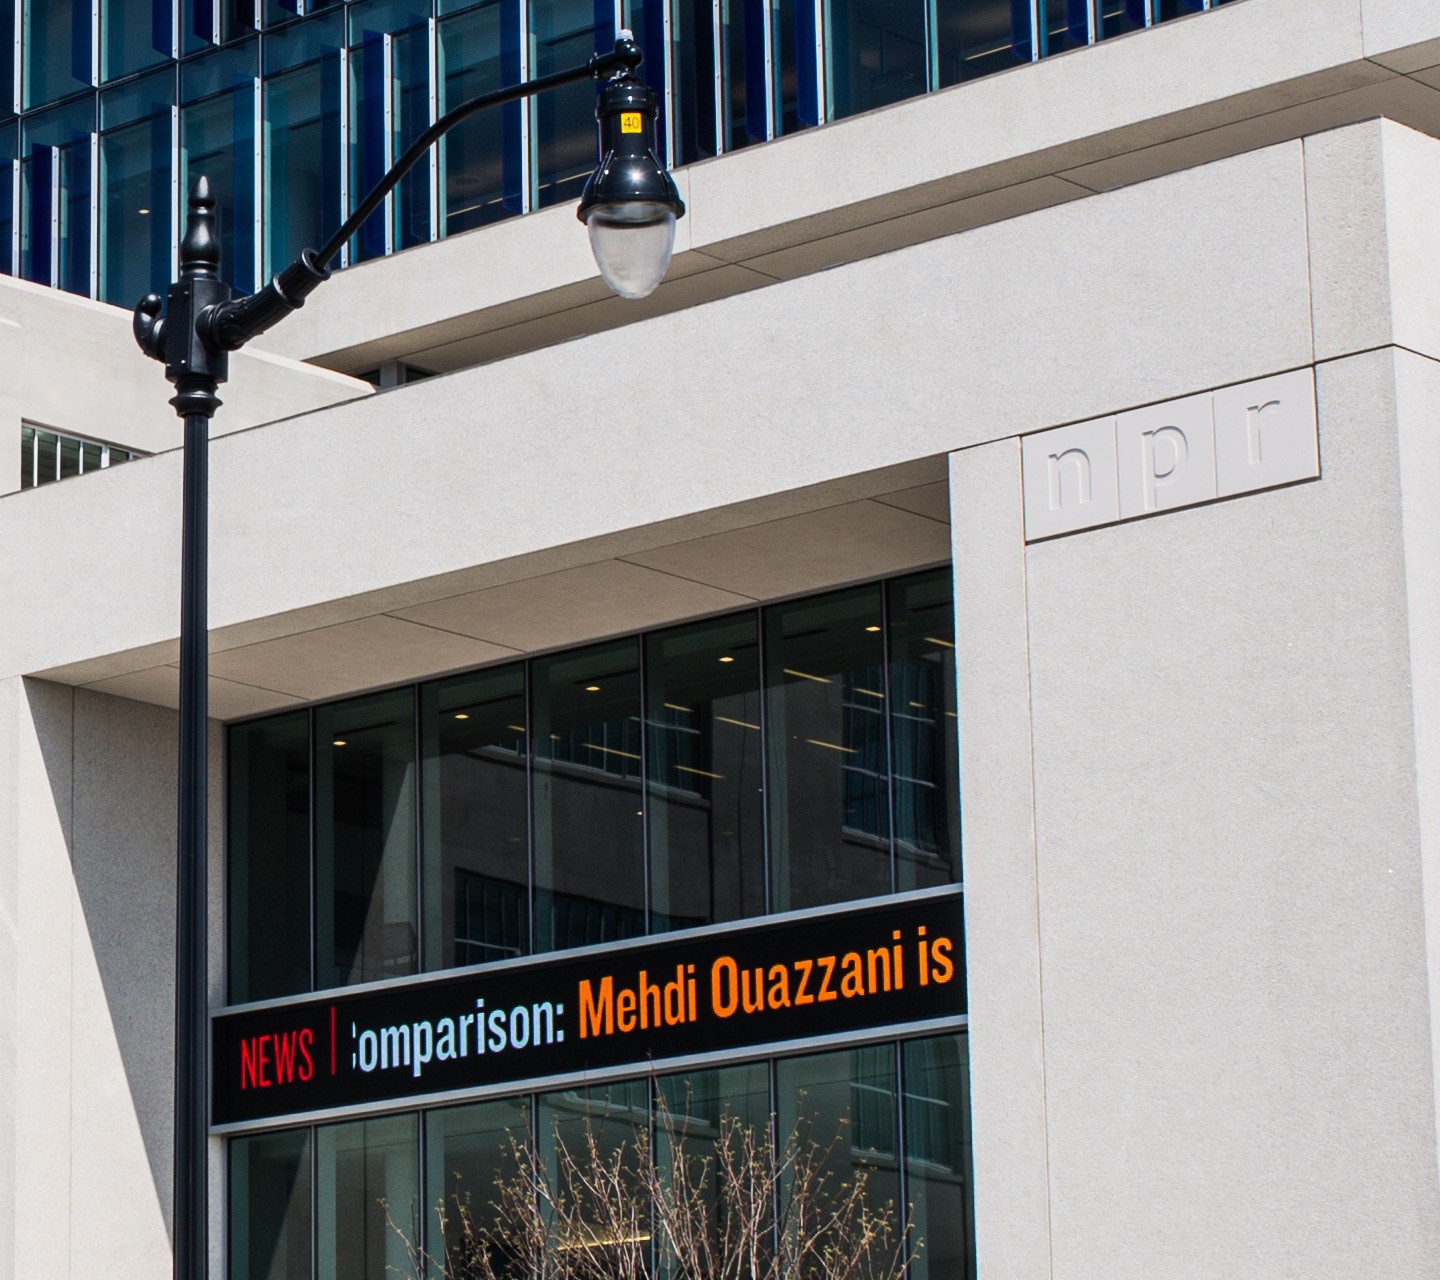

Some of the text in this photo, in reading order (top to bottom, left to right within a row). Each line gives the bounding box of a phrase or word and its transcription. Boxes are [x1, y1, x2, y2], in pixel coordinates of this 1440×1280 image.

[1048, 399, 1280, 511] npr
[352, 925, 955, 1078] omparison: Mehdi Ouazzani is
[239, 1027, 314, 1091] NEWS
